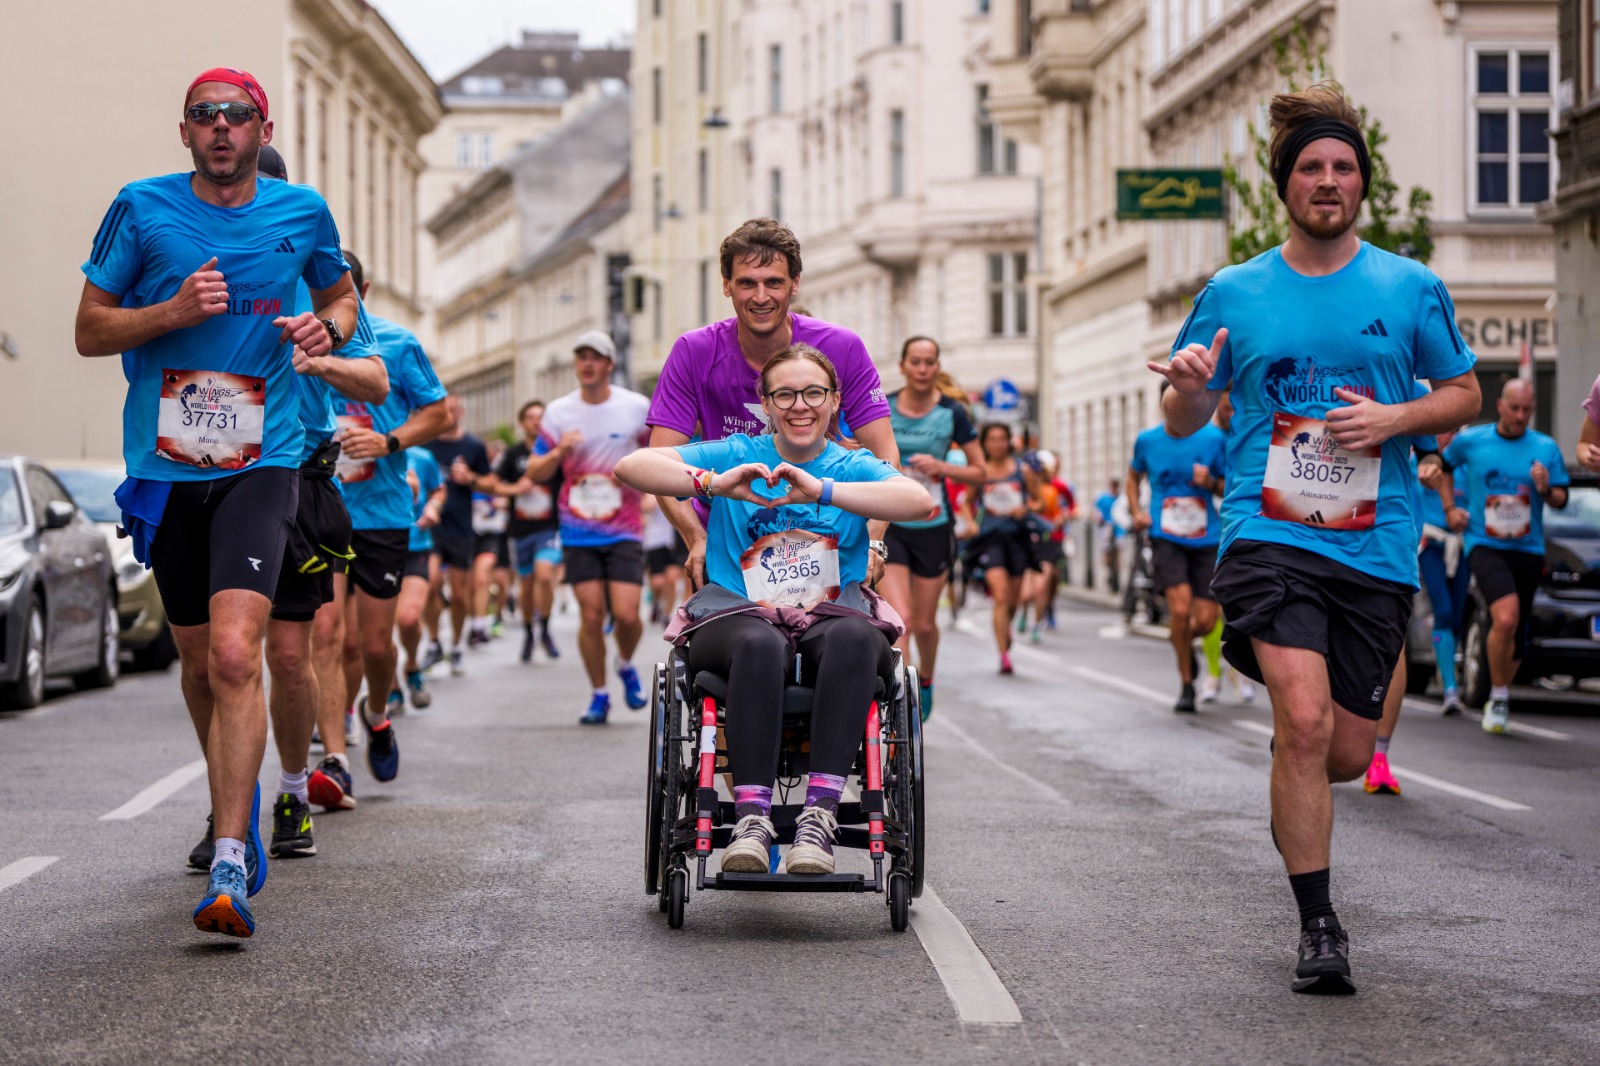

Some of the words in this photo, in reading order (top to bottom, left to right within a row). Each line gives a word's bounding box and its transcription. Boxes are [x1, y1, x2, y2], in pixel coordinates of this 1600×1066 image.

[226, 283, 251, 292] NGS
[1297, 367, 1338, 377] WINGS
[1302, 376, 1326, 385] LIFE
[199, 386, 231, 398] WINGS
[202, 394, 220, 404] LIFE
[182, 410, 237, 430] 37731
[723, 415, 757, 430] Wings
[722, 425, 734, 434] for
[199, 436, 219, 445] Mario
[1316, 445, 1337, 456] LIFE
[1334, 456, 1348, 465] 2025
[1291, 460, 1355, 484] 38057
[1300, 489, 1340, 501] Alexander
[1351, 506, 1358, 519] 1
[777, 519, 811, 529] WINGS
[776, 541, 806, 555] WINGS
[782, 550, 798, 560] LIFE
[767, 560, 820, 585] 42365
[787, 586, 806, 595] Maria
